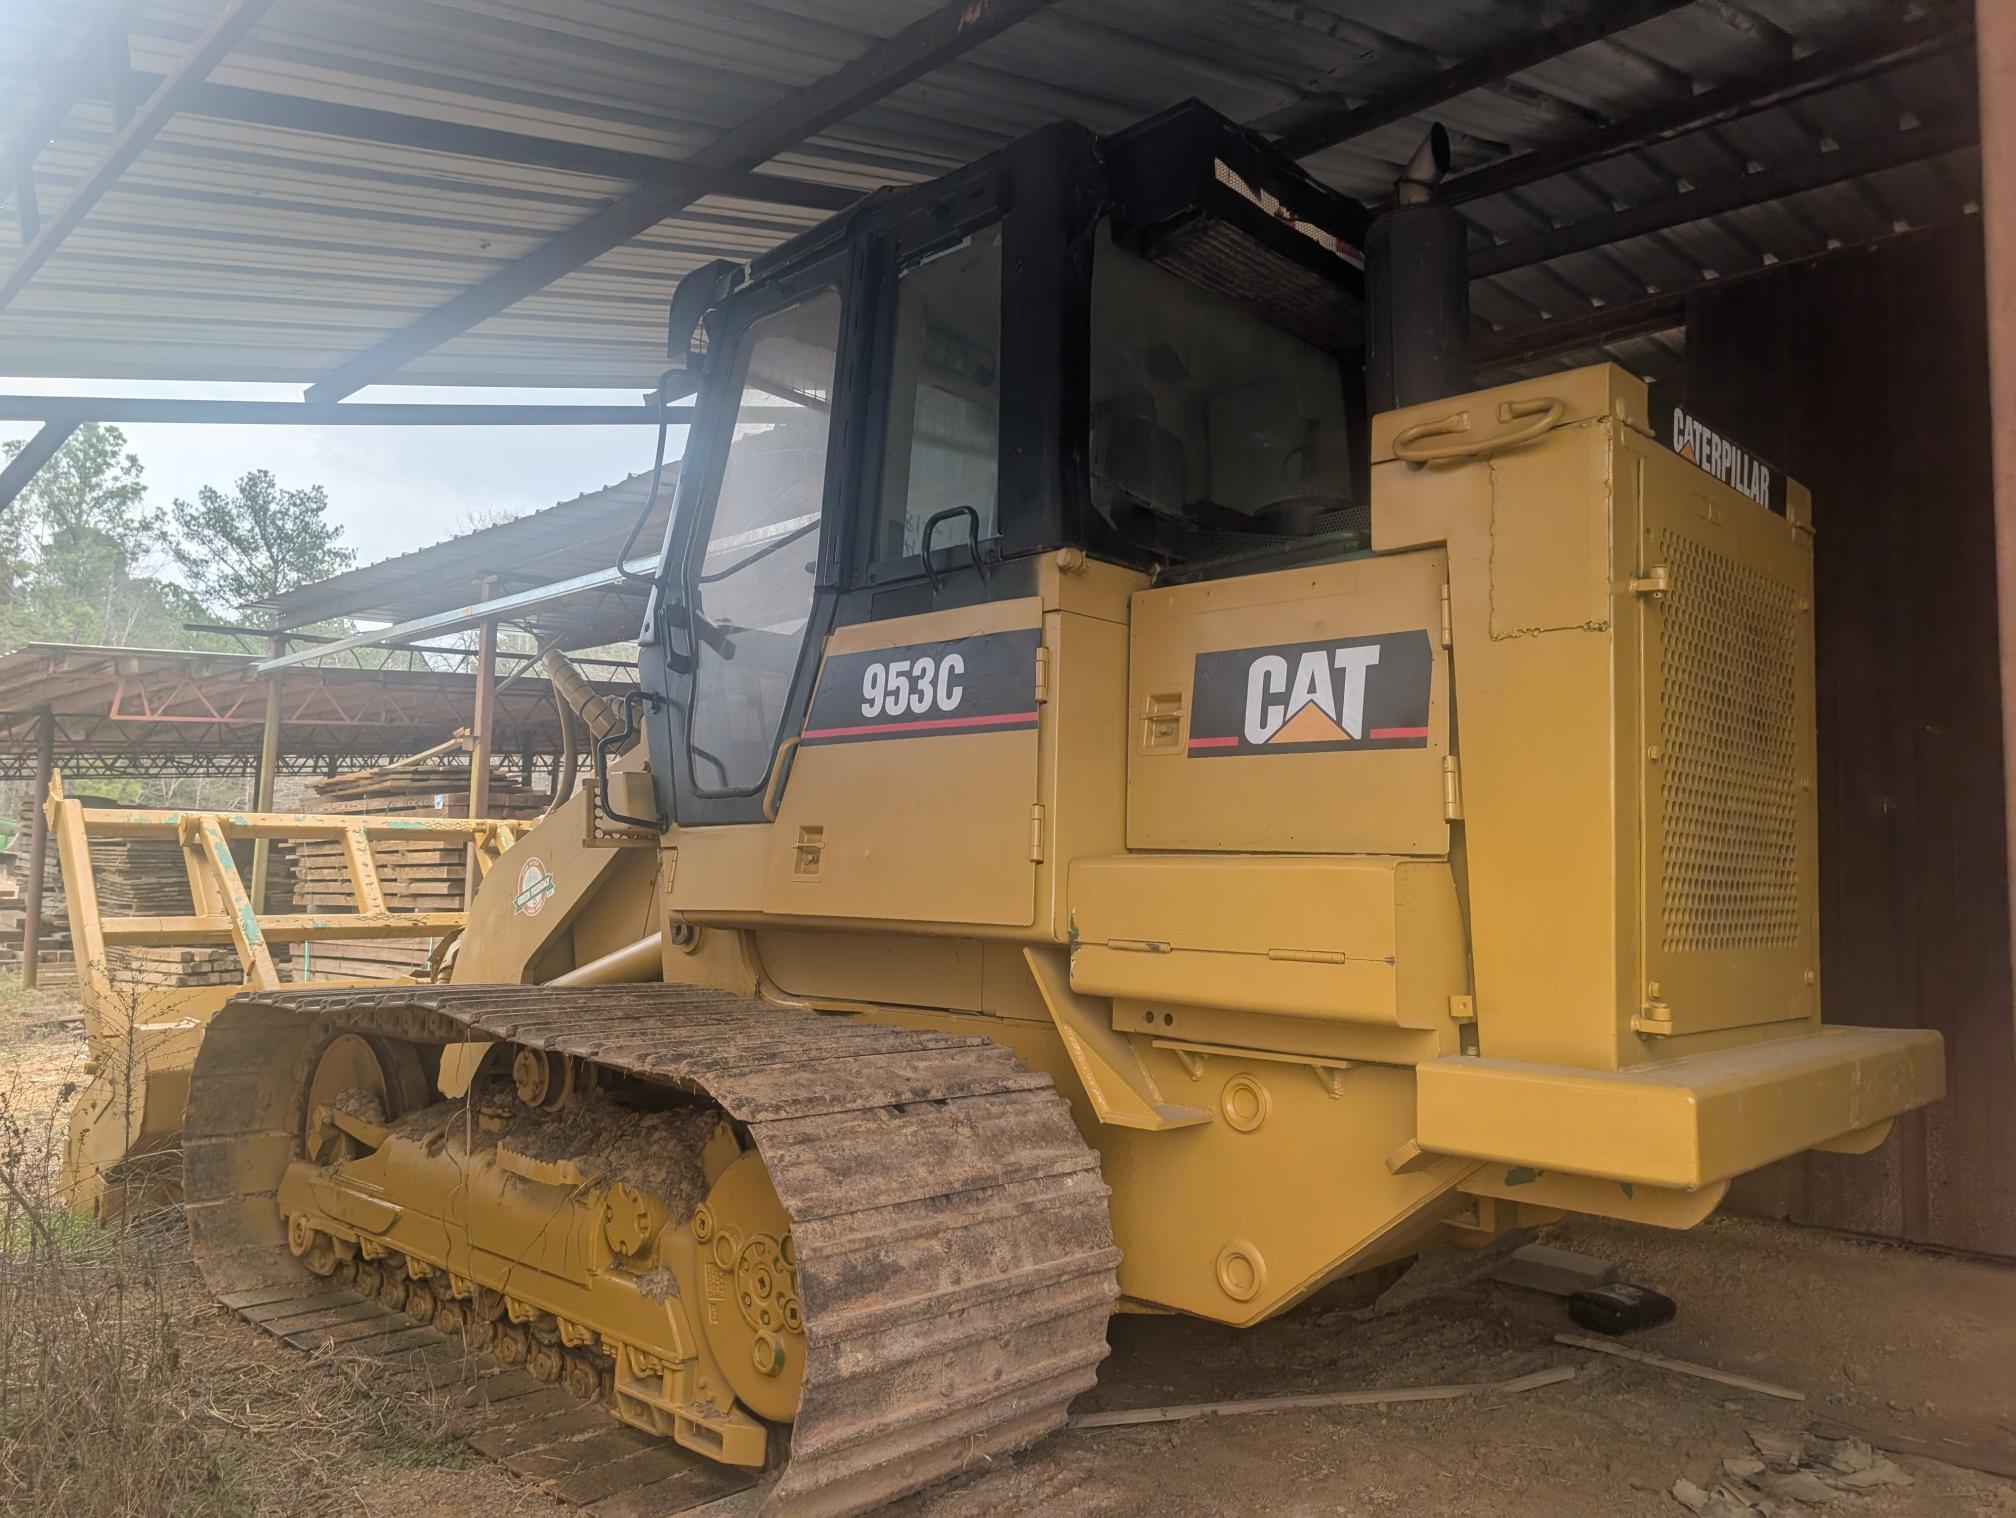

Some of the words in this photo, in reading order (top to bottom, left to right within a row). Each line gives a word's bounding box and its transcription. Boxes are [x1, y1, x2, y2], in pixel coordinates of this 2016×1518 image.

[1673, 407, 1770, 510] CATERPILLAR
[861, 653, 965, 718] 953C
[1244, 644, 1381, 744] CAT
